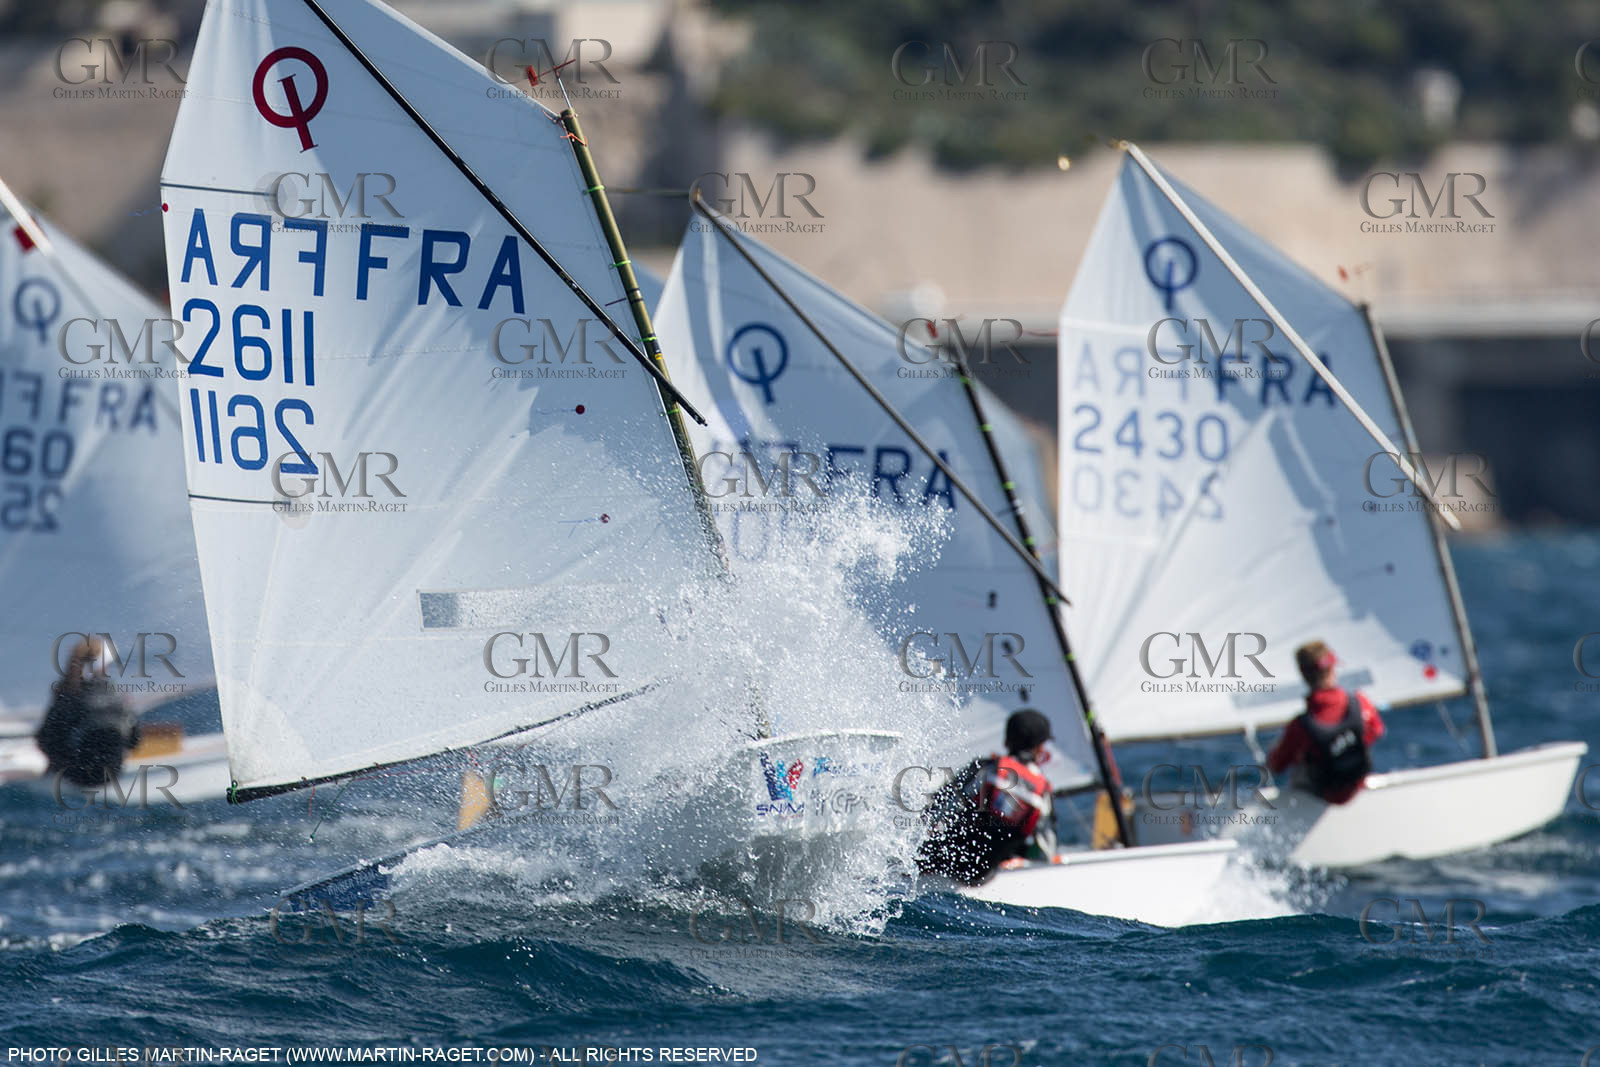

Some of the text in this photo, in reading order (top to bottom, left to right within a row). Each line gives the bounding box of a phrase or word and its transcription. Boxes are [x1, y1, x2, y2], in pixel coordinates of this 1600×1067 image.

[356, 224, 526, 315] FRA
[182, 298, 315, 387] 2611
[58, 377, 157, 434] FRA
[1216, 351, 1337, 408] FRA
[1073, 403, 1230, 464] 2430
[824, 444, 957, 510] FRA
